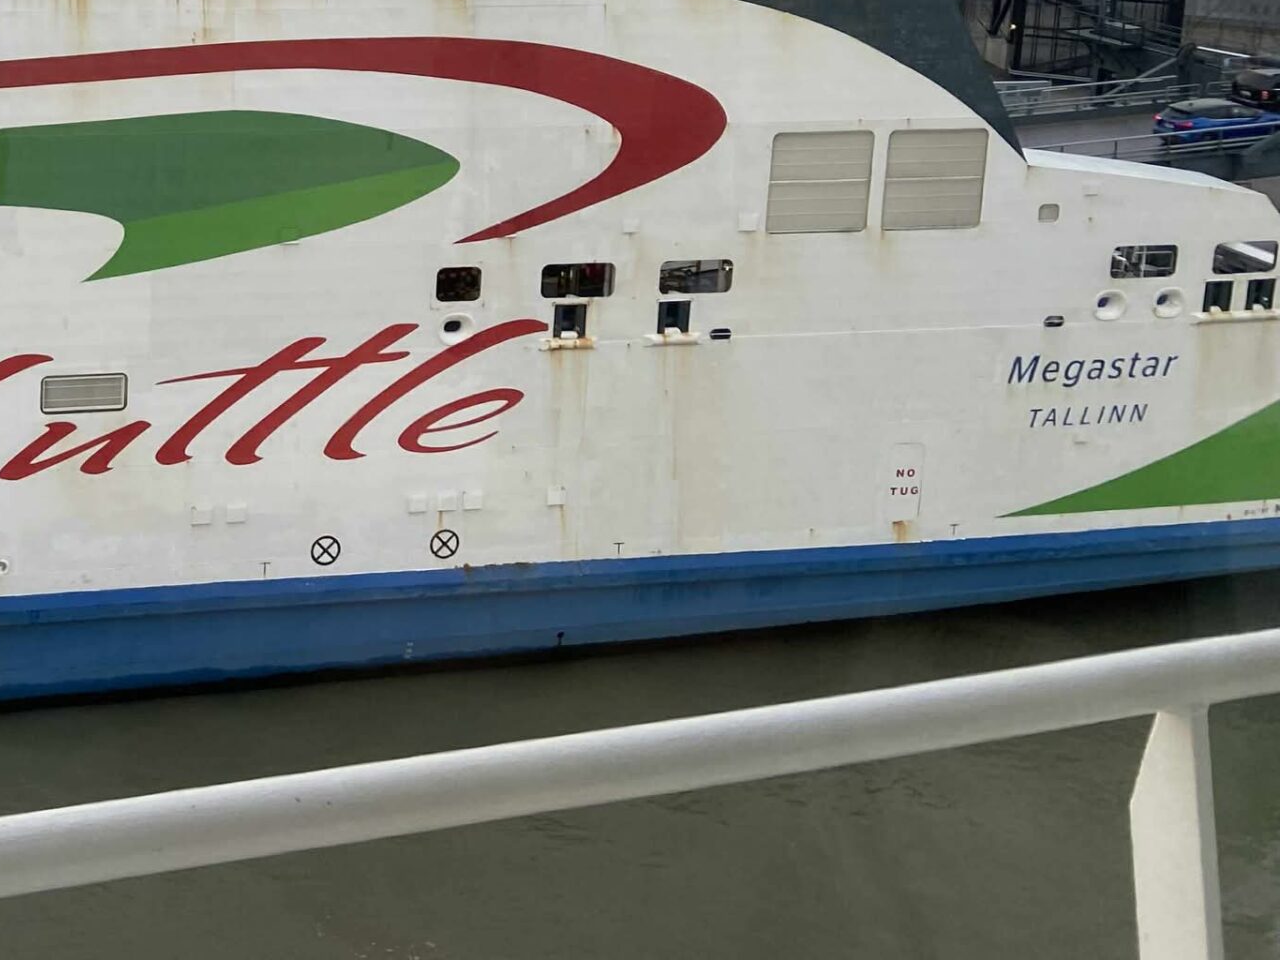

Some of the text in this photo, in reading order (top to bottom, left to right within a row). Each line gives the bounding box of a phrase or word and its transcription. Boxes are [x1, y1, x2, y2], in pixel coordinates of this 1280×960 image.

[1007, 352, 1179, 388] Megastar
[1029, 403, 1149, 428] TALLINN
[895, 468, 916, 478] NO
[889, 486, 919, 496] TUG
